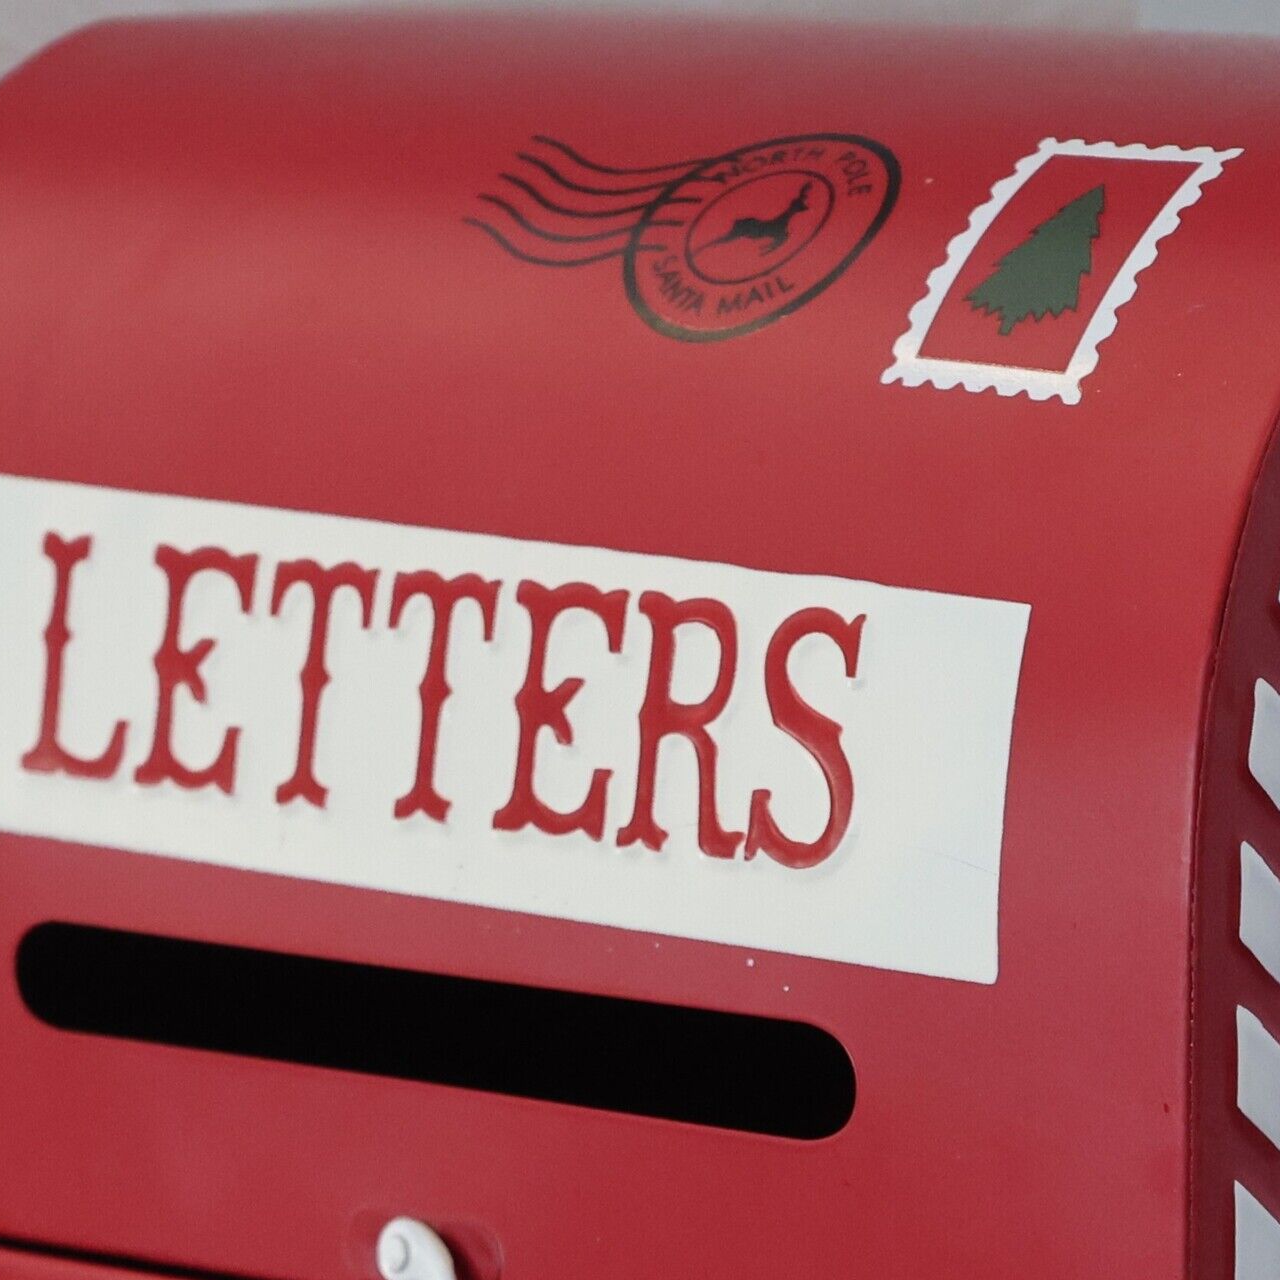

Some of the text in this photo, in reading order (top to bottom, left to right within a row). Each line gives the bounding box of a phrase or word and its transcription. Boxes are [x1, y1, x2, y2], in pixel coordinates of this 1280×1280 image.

[720, 148, 873, 195] NORTH POLE
[652, 255, 795, 316] SANTA MAIL
[21, 531, 866, 868] LETTERS
